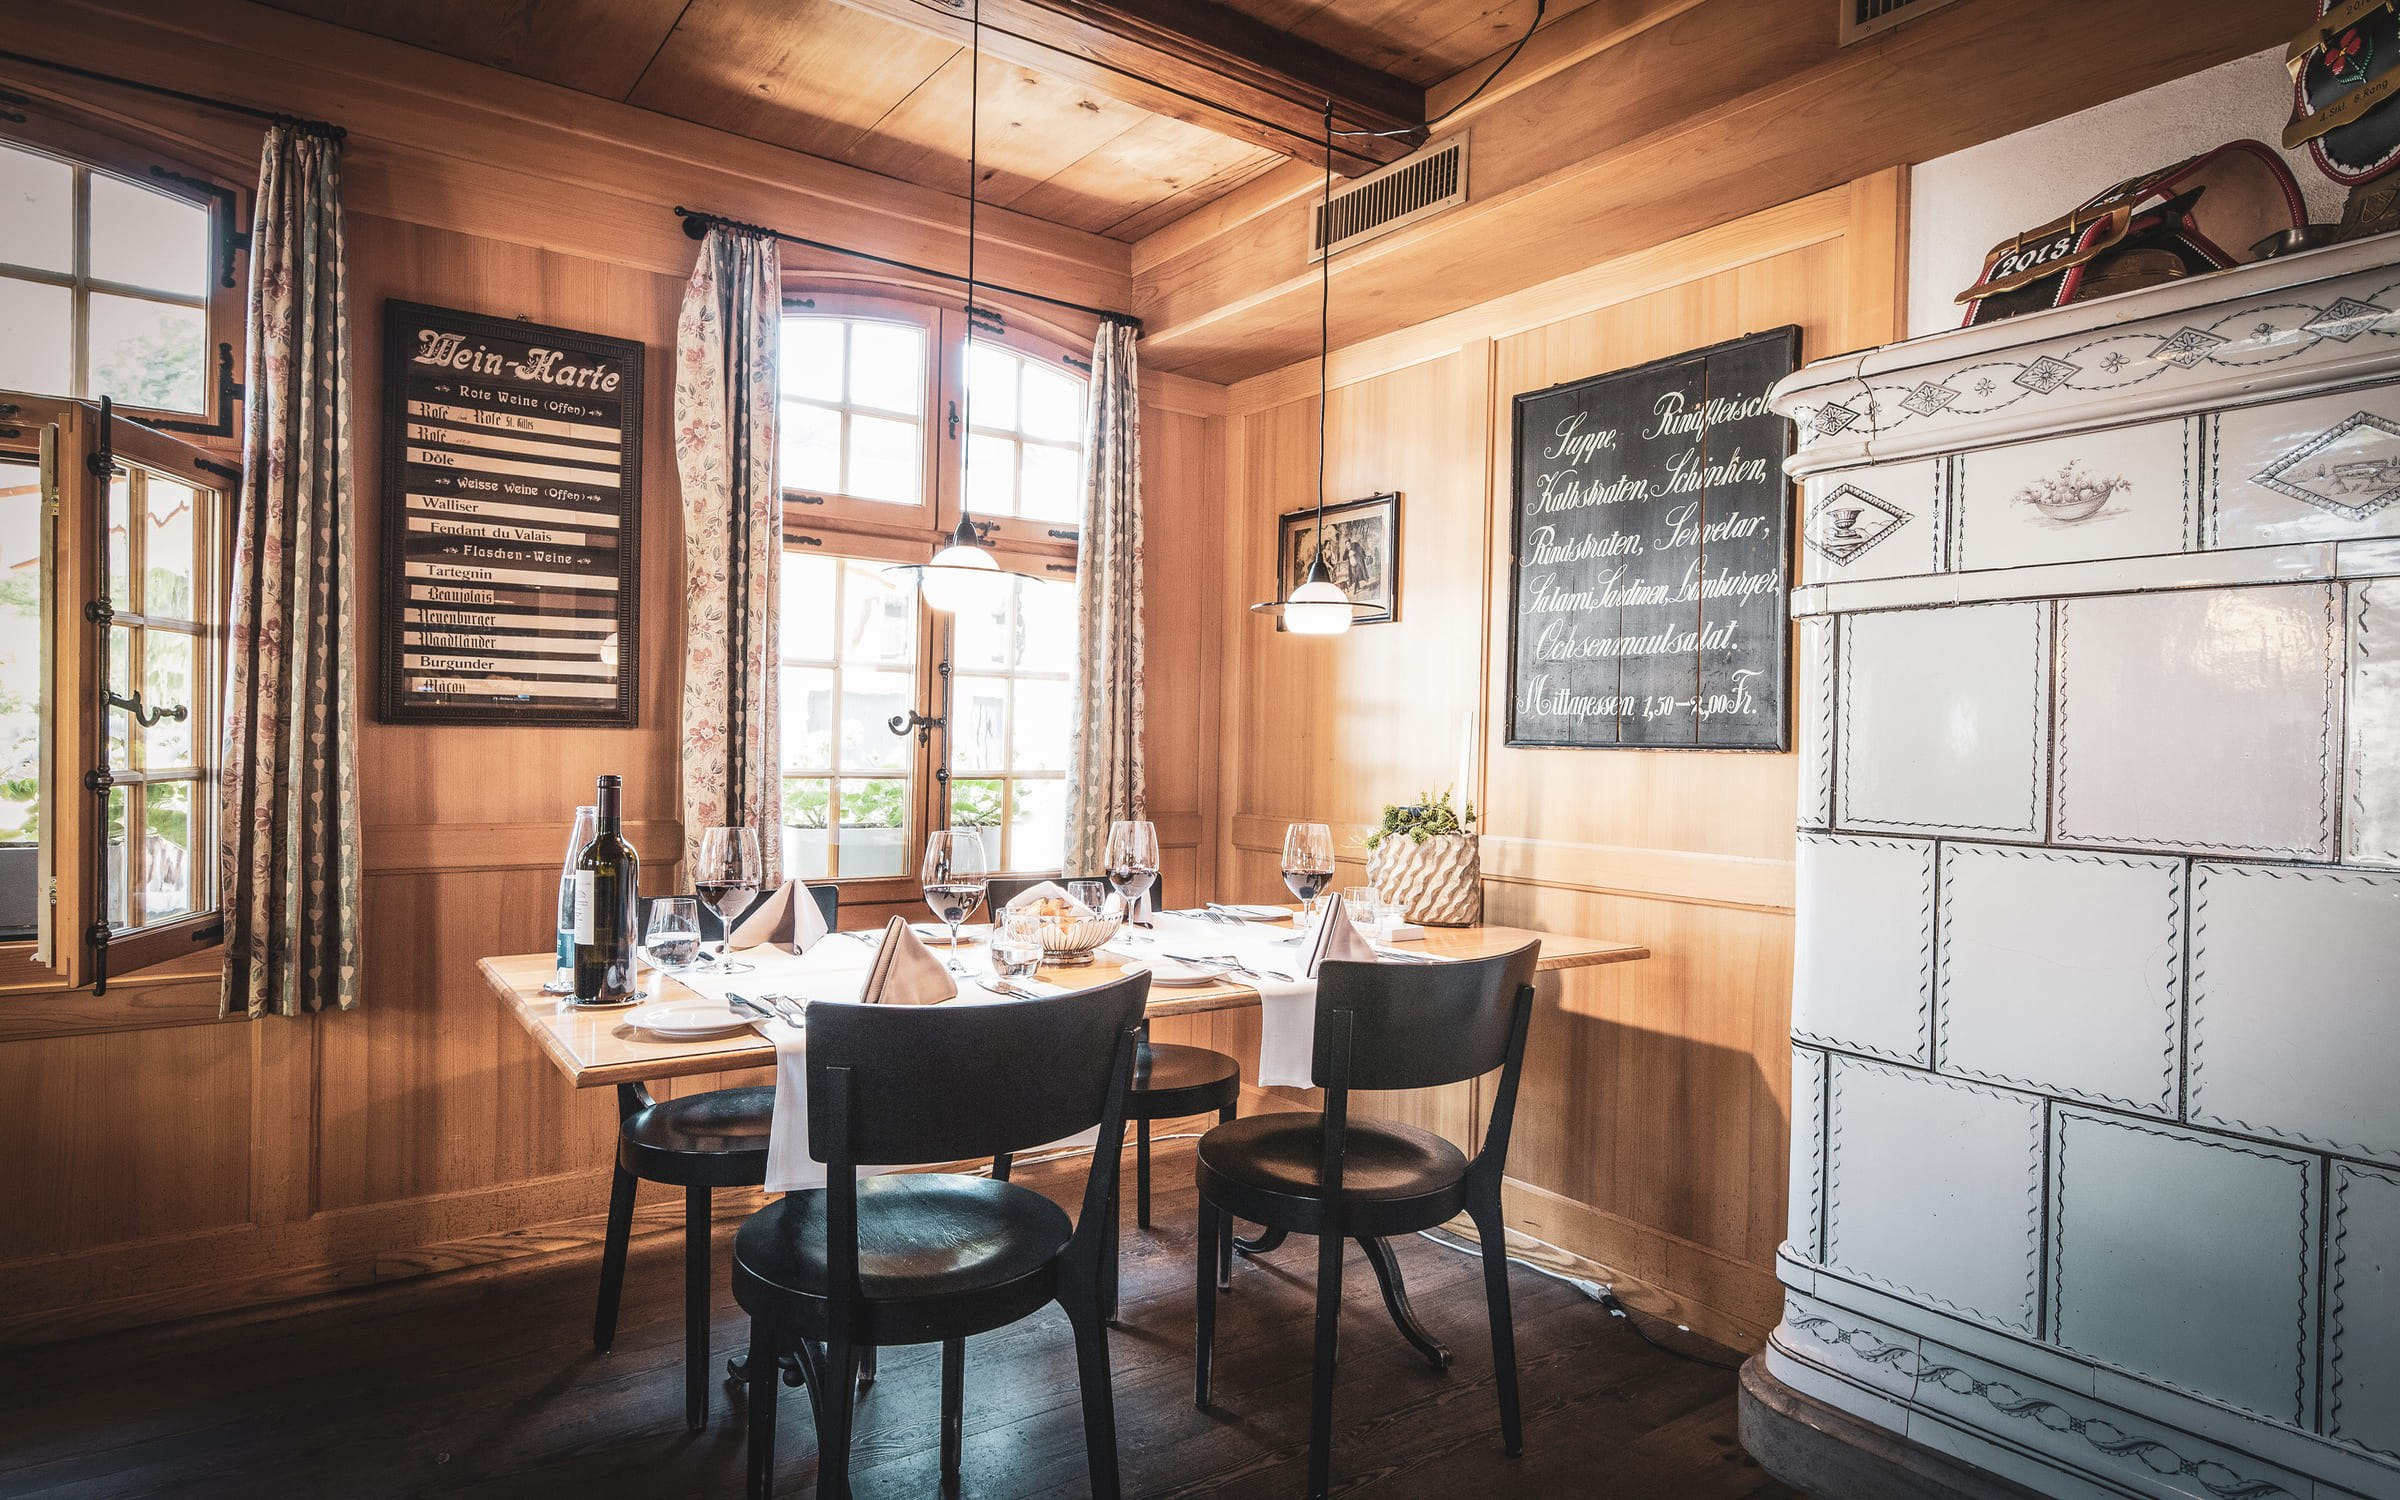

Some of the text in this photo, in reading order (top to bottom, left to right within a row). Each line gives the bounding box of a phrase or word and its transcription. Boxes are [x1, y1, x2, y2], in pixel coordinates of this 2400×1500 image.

[2345, 0, 2369, 15] 201
[1996, 237, 2071, 280] 2018
[411, 329, 620, 392] Wein-Karte
[460, 385, 586, 416] Rote Weine (Offen)
[1544, 411, 1617, 466] Suppe,
[422, 450, 455, 466] Dôle
[456, 476, 586, 501] Weisse Weine (Offen)
[1526, 447, 1767, 516] Kalbsbraten, Schinken,
[422, 496, 479, 513] Walliser
[430, 522, 552, 542] Fendant du Valais
[1519, 523, 1644, 568] Rindsbraten,
[426, 564, 492, 580] Tartegnin
[428, 586, 493, 603] Beaujolais
[1519, 572, 1595, 615] Salami,
[1591, 563, 1668, 609] Sardinen,
[417, 608, 496, 627] Neuenburger
[418, 631, 497, 649] Waadtländer
[1536, 618, 1739, 660] Ochsenmaulsalat.
[420, 655, 495, 672] Burgunder
[1516, 673, 1635, 726] Mittagessen
[1725, 668, 1766, 715] Fr.
